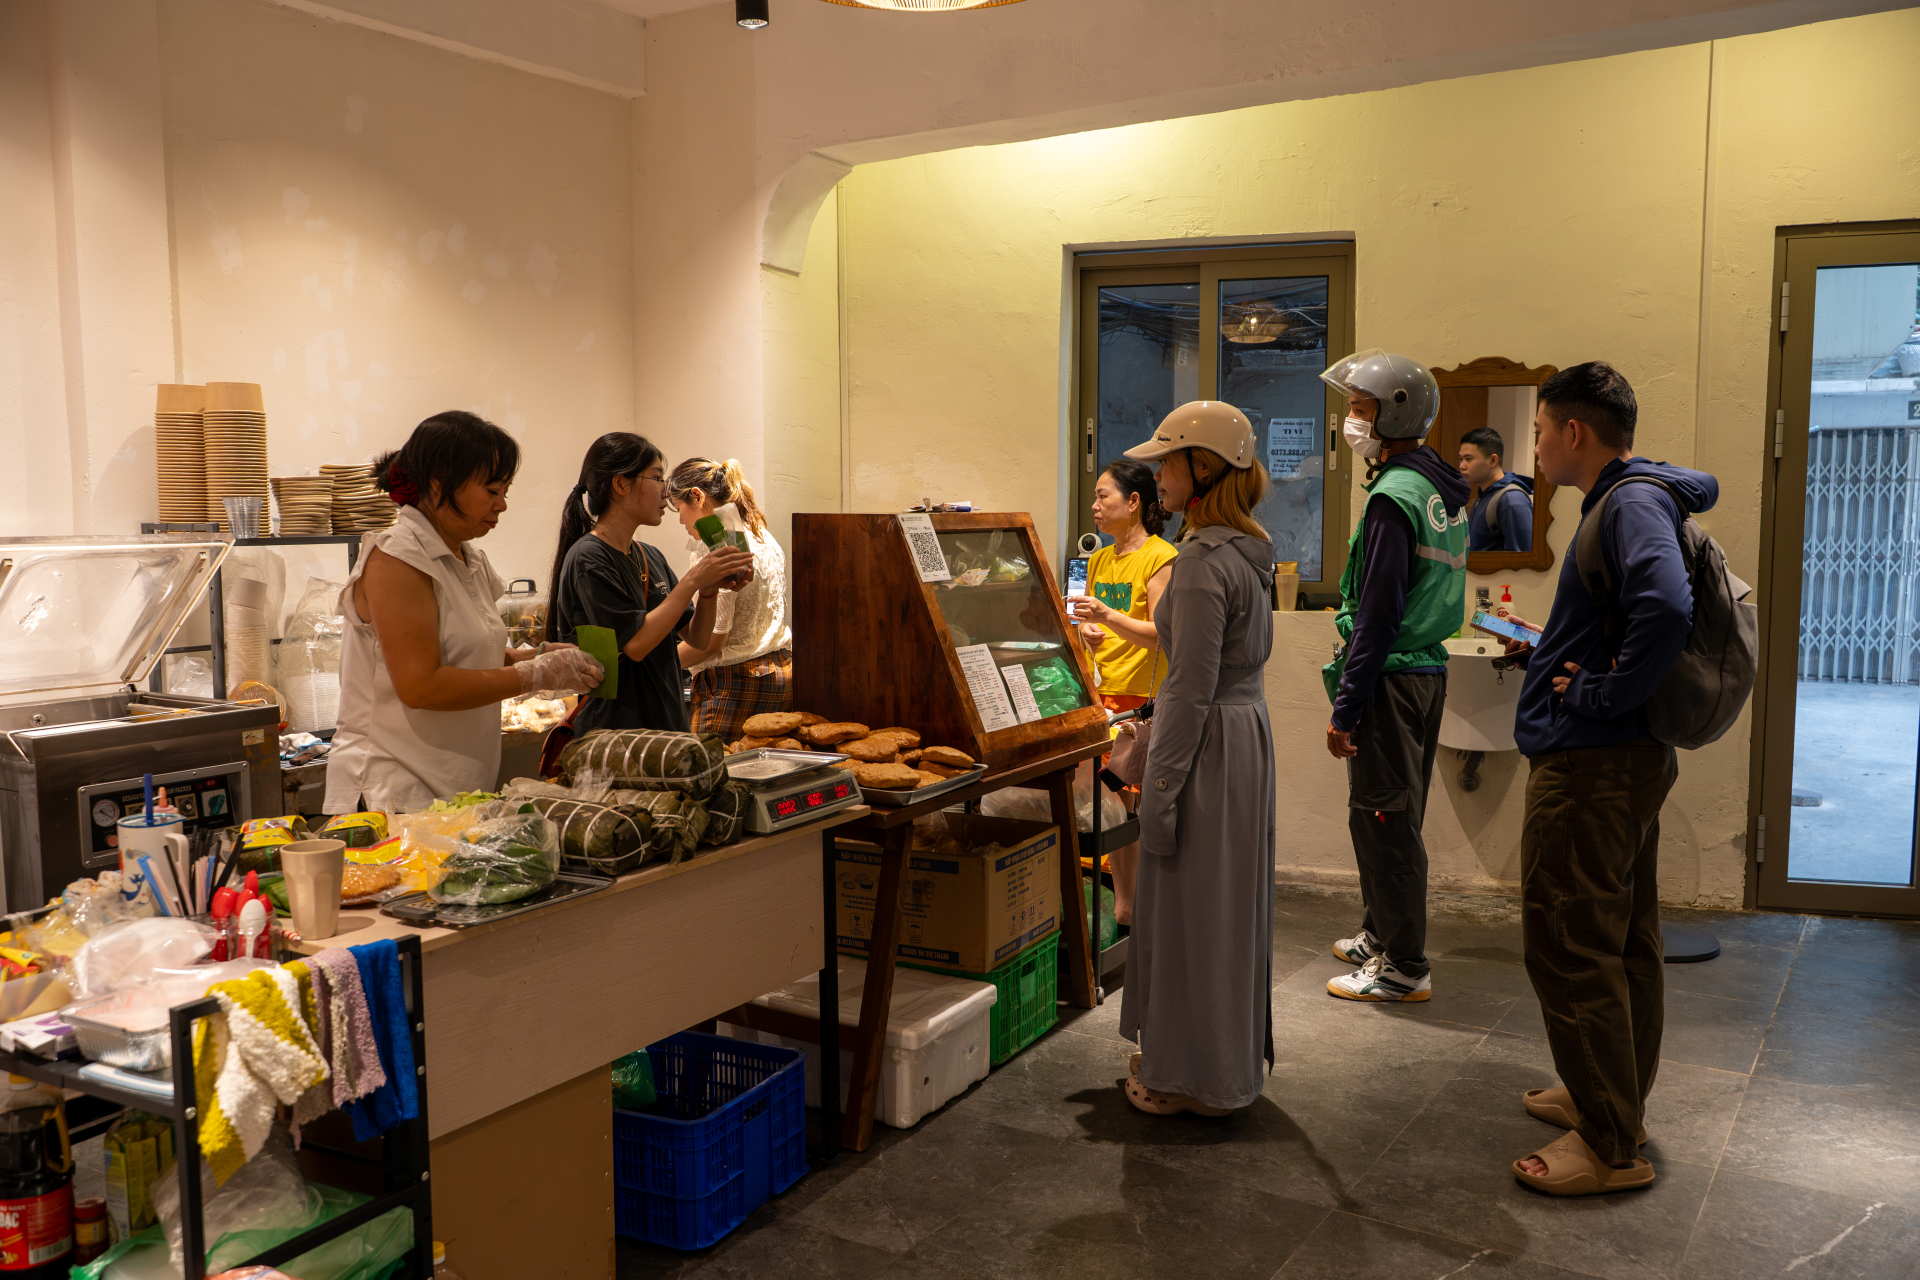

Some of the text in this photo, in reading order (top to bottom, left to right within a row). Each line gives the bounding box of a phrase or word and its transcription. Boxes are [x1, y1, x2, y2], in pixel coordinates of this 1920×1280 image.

[174, 785, 192, 793] PACKER
[902, 947, 949, 961] MADE IN VIETNAM
